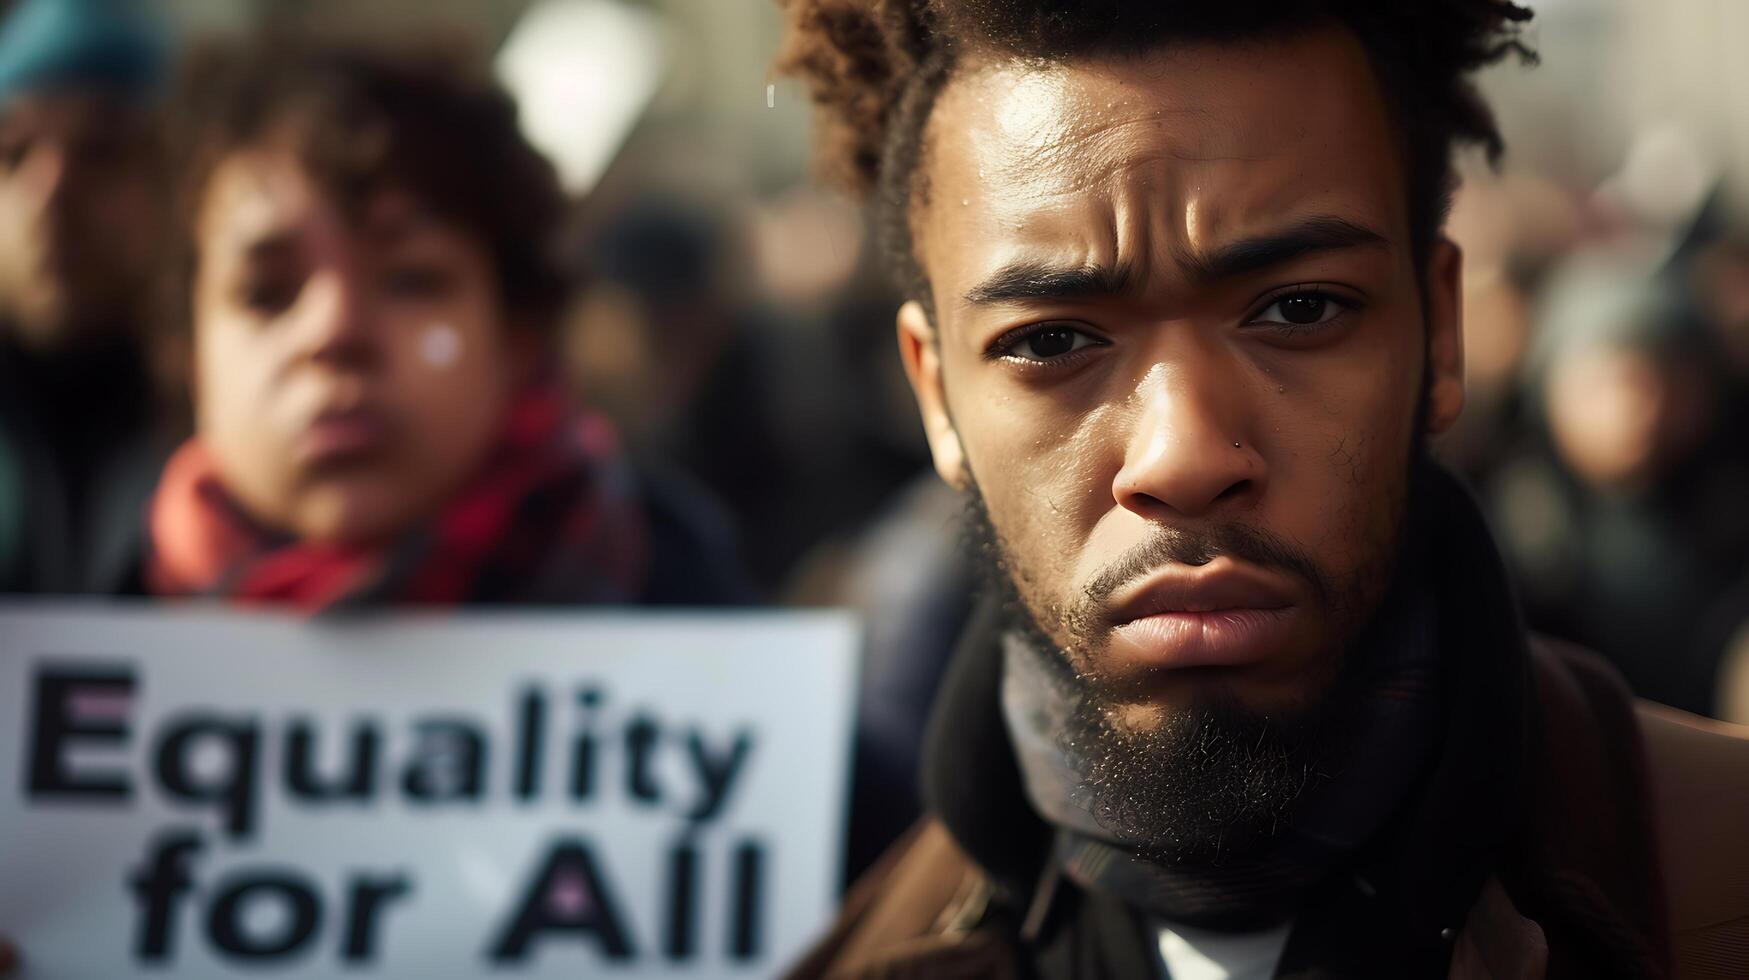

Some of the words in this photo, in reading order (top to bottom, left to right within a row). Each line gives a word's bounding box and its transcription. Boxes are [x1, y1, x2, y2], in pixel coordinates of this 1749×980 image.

[20, 658, 754, 840] Equality
[127, 831, 412, 969] for
[485, 836, 766, 969] All
